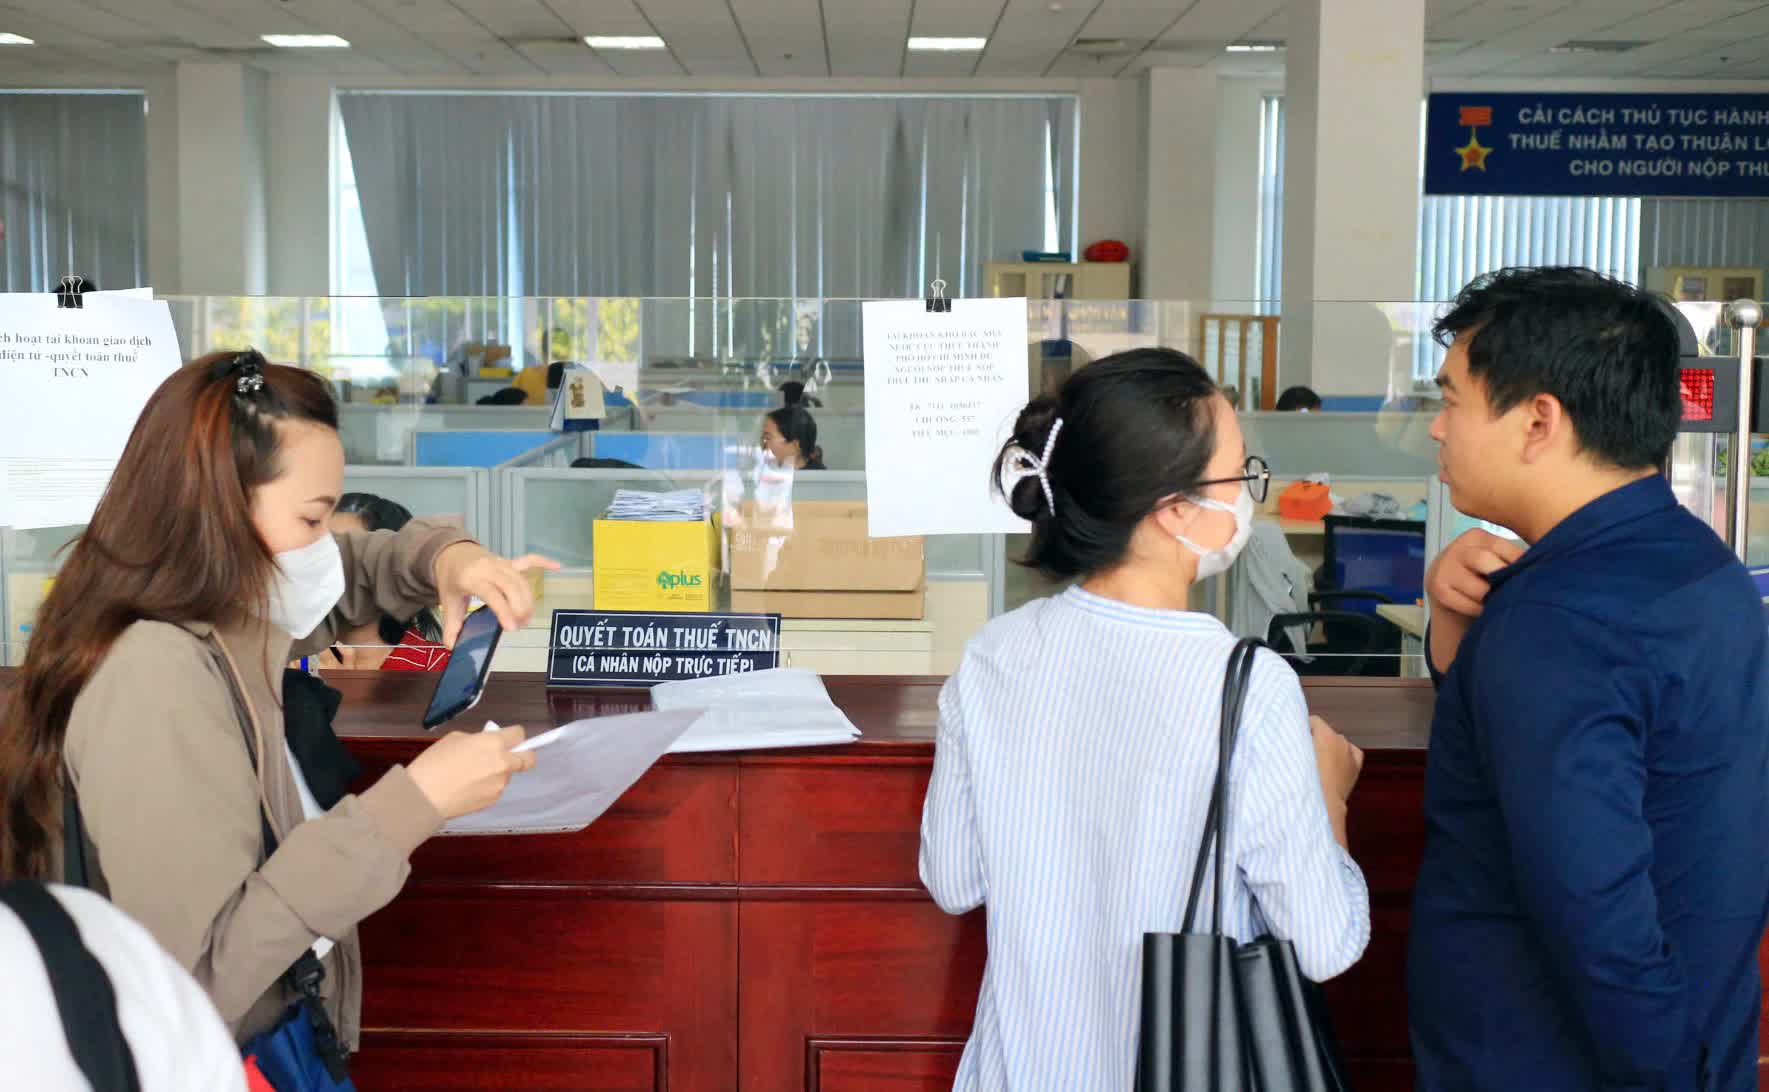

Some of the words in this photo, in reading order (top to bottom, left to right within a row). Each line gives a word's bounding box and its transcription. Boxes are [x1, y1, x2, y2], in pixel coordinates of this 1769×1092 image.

[1518, 103, 1553, 124] CẢI
[1558, 105, 1615, 124] CÁCH
[1621, 104, 1661, 125] THỦ
[1667, 110, 1707, 127] TỤC
[1509, 128, 1562, 149] THUẾ
[1633, 134, 1675, 152] TẠO
[1569, 160, 1613, 176] CHO
[1618, 156, 1682, 176] NGƯỜI
[1688, 157, 1730, 180] NỘP
[103, 335, 126, 346] giao
[129, 335, 152, 348] dịch
[560, 619, 617, 649] QUYẾT
[622, 622, 668, 648] TOÁN
[674, 620, 722, 649] THUẾ
[725, 628, 771, 651] TNCN
[573, 651, 595, 673] (CÁ
[600, 653, 638, 673] NHÂN
[643, 653, 671, 677] NỘP
[675, 655, 713, 678] TRỰC
